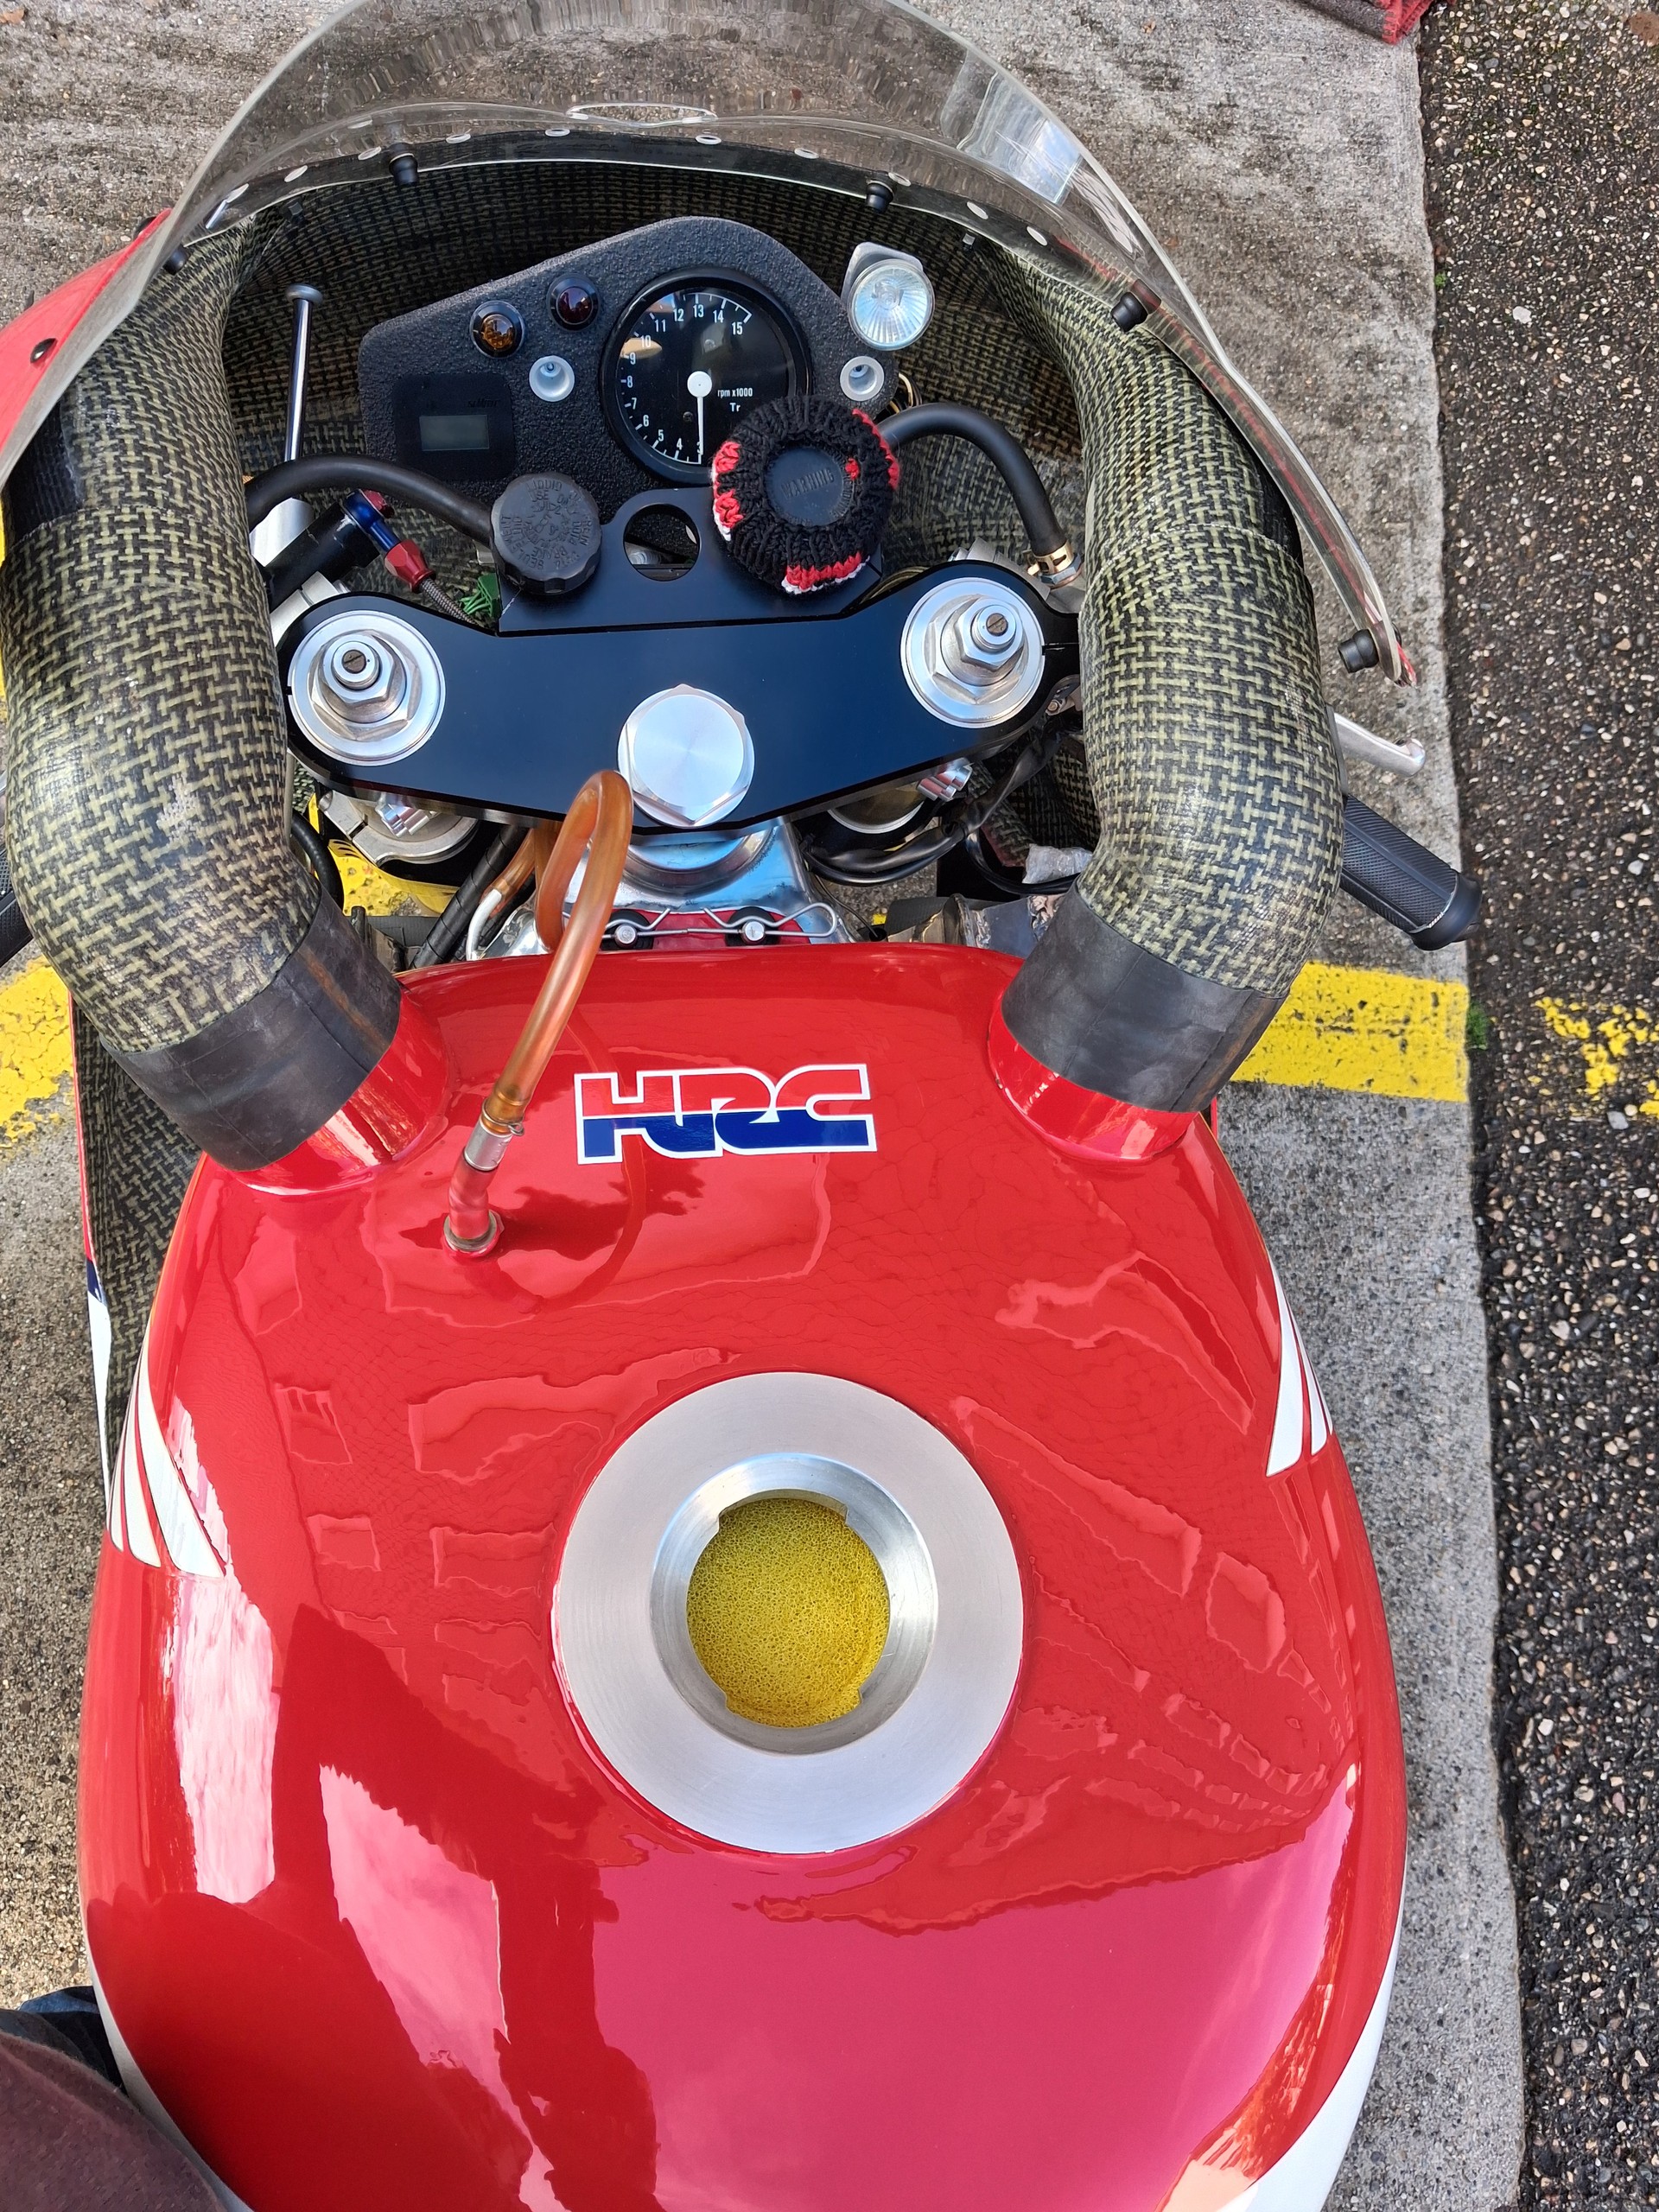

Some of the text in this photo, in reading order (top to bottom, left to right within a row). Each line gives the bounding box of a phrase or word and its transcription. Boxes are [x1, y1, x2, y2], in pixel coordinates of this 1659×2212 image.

[673, 308, 684, 322] 12
[692, 305, 703, 318] 13
[713, 310, 724, 323] 14
[654, 320, 666, 333] 11
[731, 322, 743, 335] 15
[641, 335, 652, 348] 10
[629, 353, 636, 365] 9
[626, 376, 633, 388] 8
[717, 387, 753, 397] rpm x1000
[631, 397, 637, 410] 7
[729, 403, 741, 412] Tr
[642, 415, 649, 427] 6
[658, 429, 664, 442] 5
[676, 438, 683, 450] 4
[696, 442, 702, 454] 3
[780, 467, 835, 499] WARNING
[531, 490, 550, 502] USE
[574, 1064, 878, 1165] HRC
